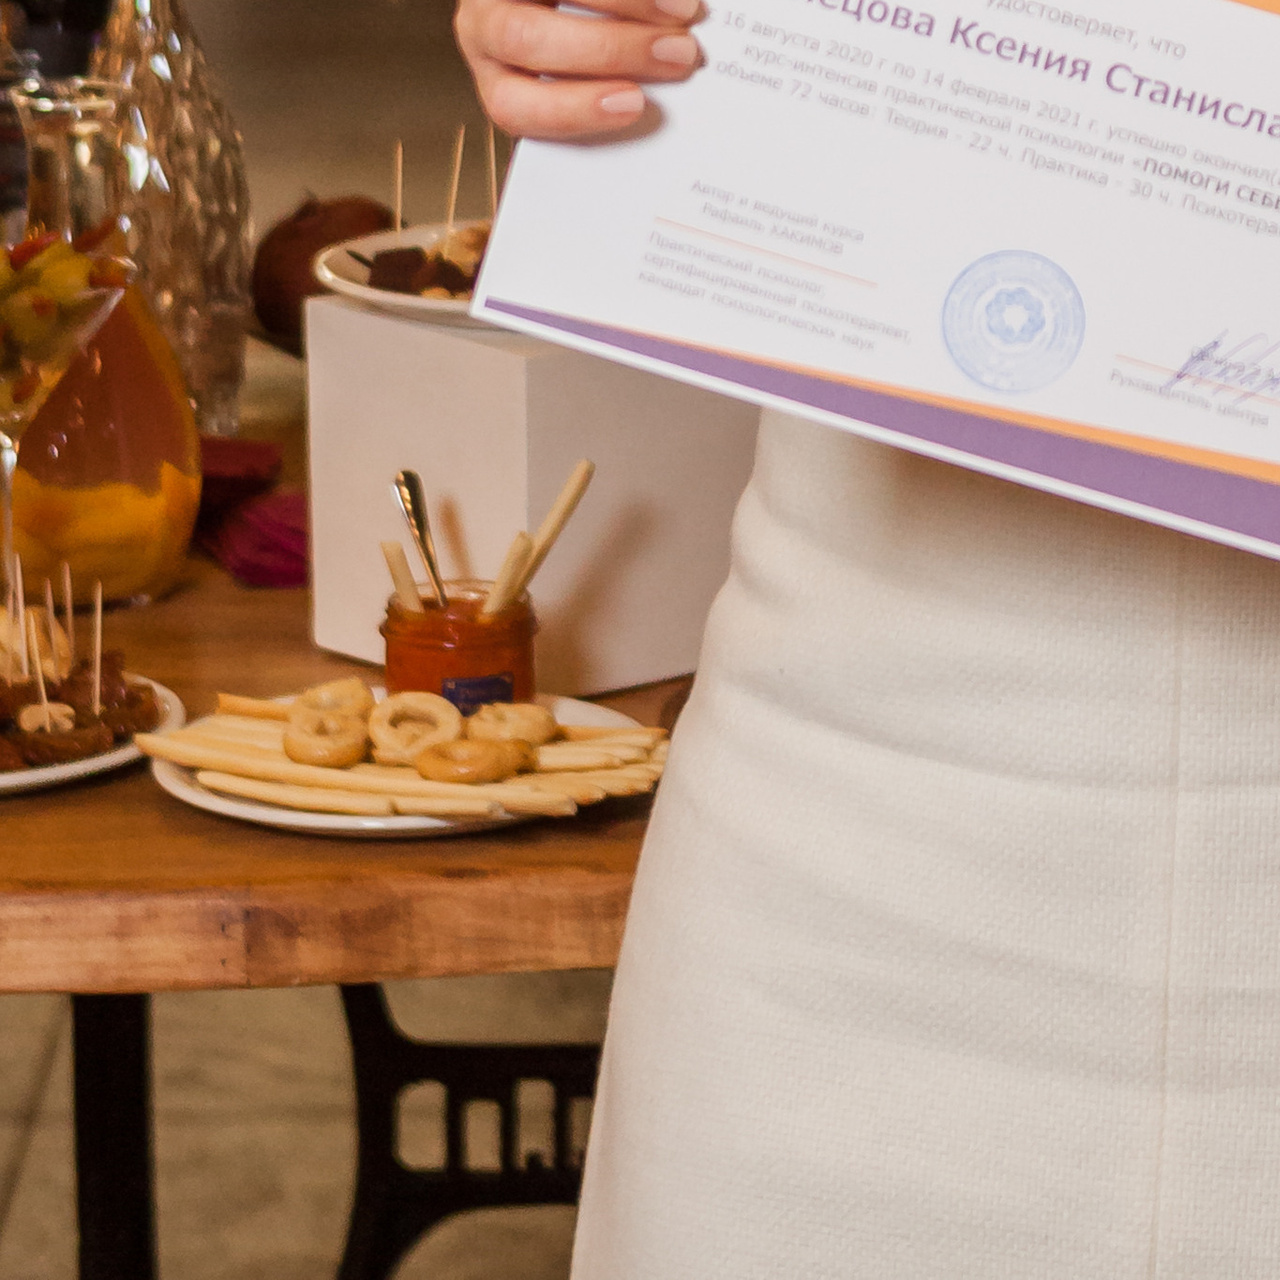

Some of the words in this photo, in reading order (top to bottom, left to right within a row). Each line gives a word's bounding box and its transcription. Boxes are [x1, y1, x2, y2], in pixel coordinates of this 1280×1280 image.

[949, 17, 1091, 82] Ксения
[1150, 36, 1187, 60] что
[724, 10, 746, 29] 16
[750, 21, 821, 52] августа
[826, 39, 874, 67] 2020
[892, 62, 916, 80] по
[923, 69, 945, 88] 14
[950, 79, 1031, 113] февраля
[1036, 100, 1081, 128] 2021
[1106, 125, 1188, 158] успешно
[715, 62, 784, 91] объеме
[790, 78, 813, 100] 72
[887, 107, 949, 140] Теория
[968, 131, 993, 152] 22
[1020, 147, 1109, 187] Практика
[1129, 178, 1154, 200] 30
[743, 44, 878, 94] курс-интенсив
[883, 85, 1012, 133] практической
[1017, 124, 1125, 165] психологии
[1133, 157, 1230, 196] «ПОМОГИ
[690, 180, 734, 204] Автор
[752, 200, 819, 228] ведущий
[822, 222, 865, 242] курса
[648, 230, 753, 273] Практический
